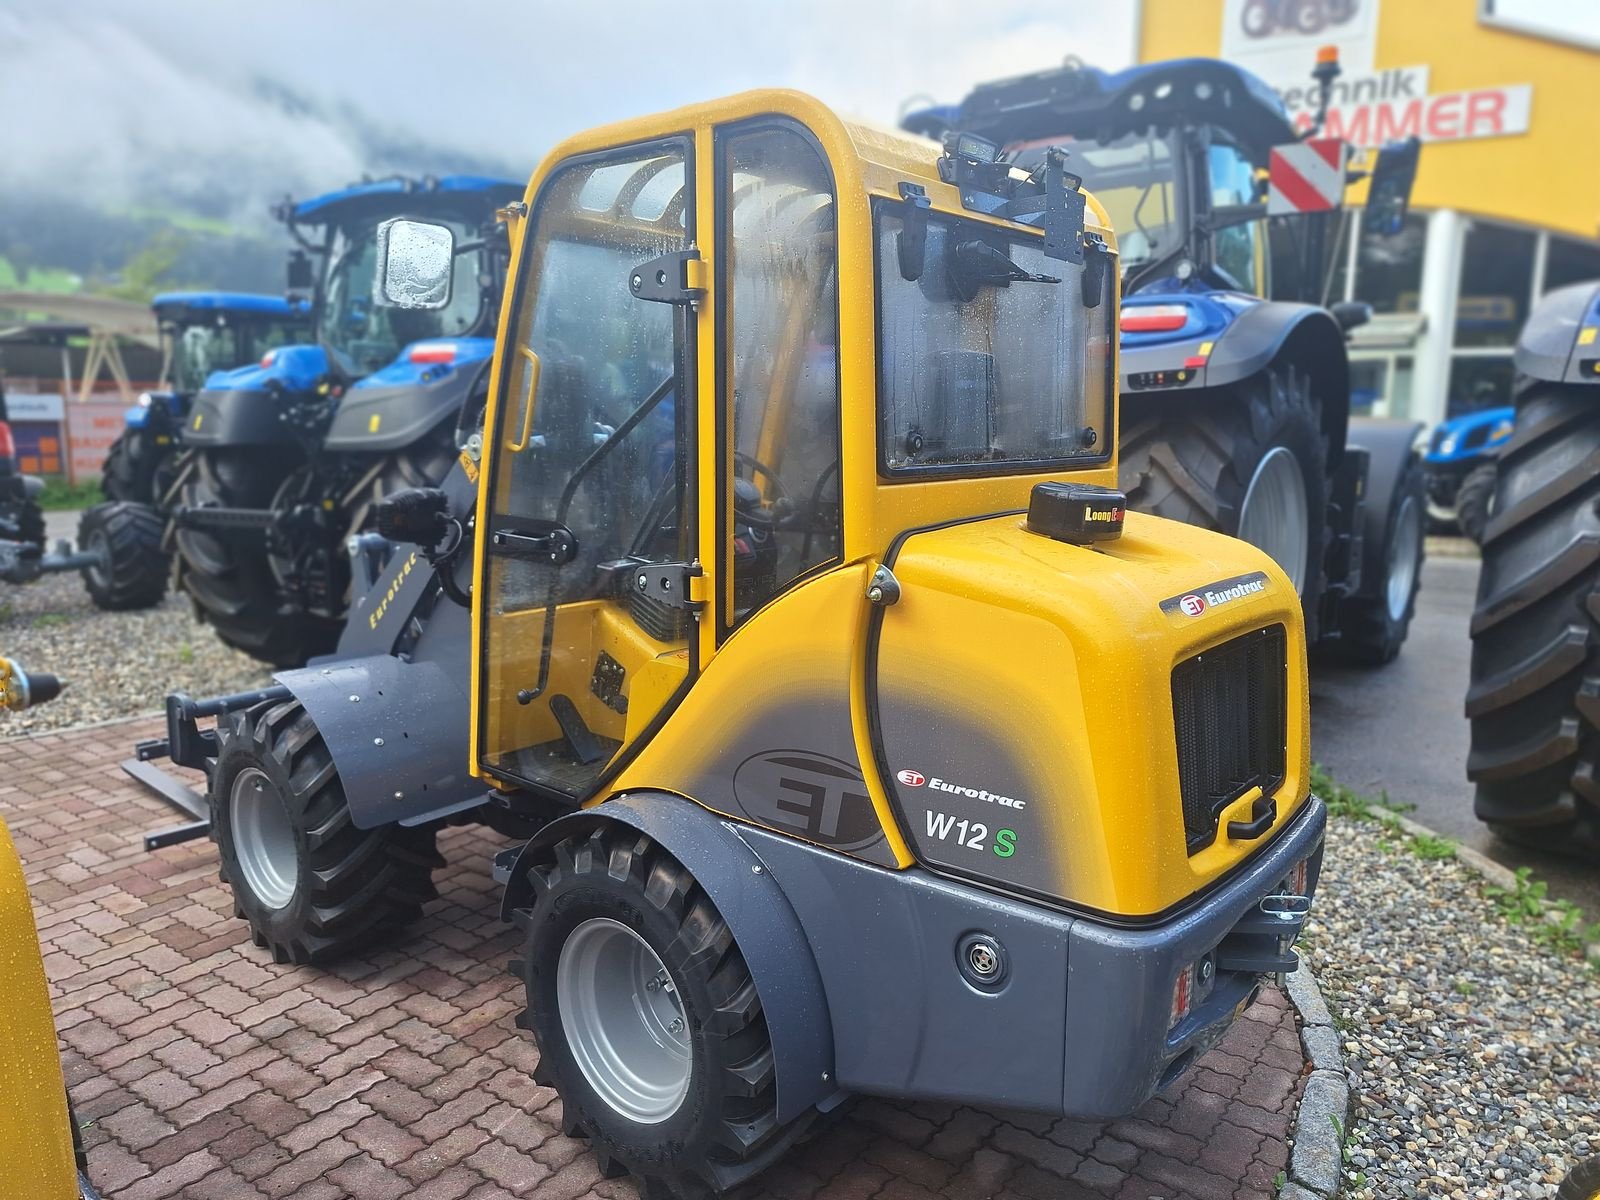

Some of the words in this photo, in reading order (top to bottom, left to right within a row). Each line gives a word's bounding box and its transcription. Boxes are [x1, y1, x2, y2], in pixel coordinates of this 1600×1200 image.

[367, 551, 417, 630] Eurotrac
[1205, 579, 1265, 607] Eurotrac
[928, 777, 1026, 810] Eurotrac
[926, 810, 988, 851] W12
[993, 829, 1018, 857] S
